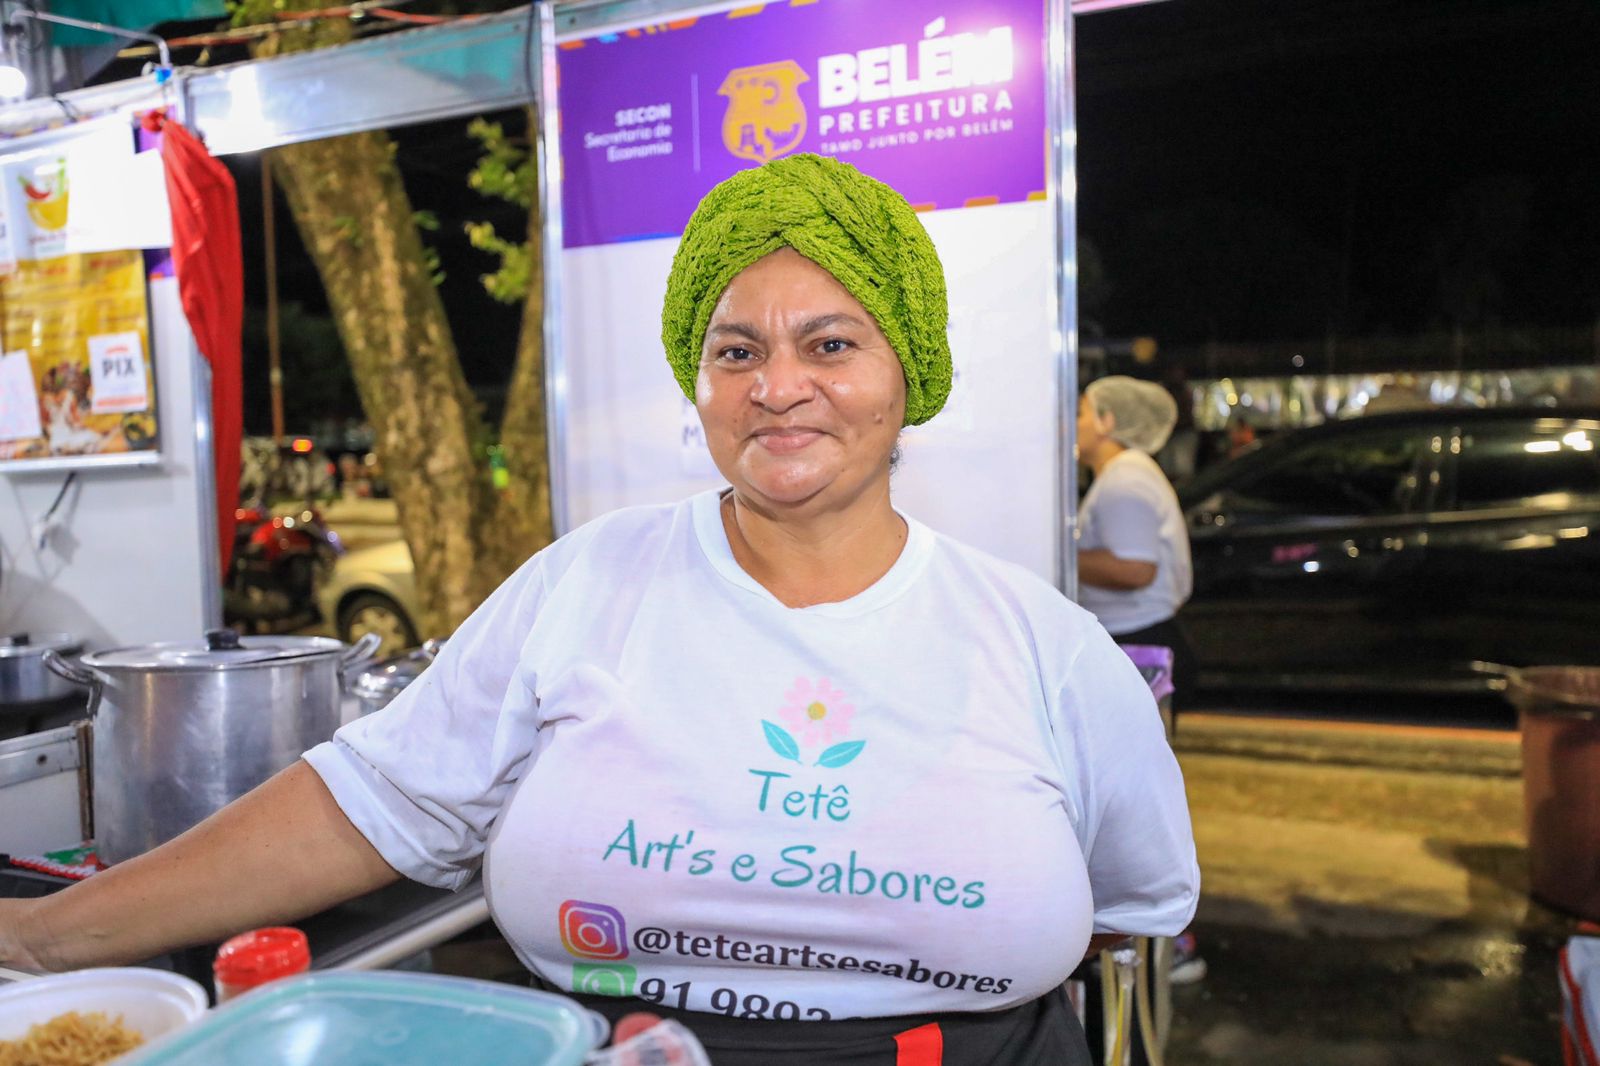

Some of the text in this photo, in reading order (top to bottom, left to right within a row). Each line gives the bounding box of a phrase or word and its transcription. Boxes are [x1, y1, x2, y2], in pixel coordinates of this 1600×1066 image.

[818, 16, 1013, 108] BELÉM
[615, 102, 672, 127] SECON
[819, 89, 1013, 136] PREFEITURA
[584, 121, 672, 149] Secretaria de
[606, 141, 673, 163] Economia
[820, 117, 1014, 154] TAMO JUNTO POR BELÉM
[102, 356, 136, 379] PIX
[748, 768, 851, 822] Tetê
[602, 819, 985, 909] Art's e Sabores
[633, 927, 1013, 995] @teteartsesabores
[640, 978, 692, 1011] 91
